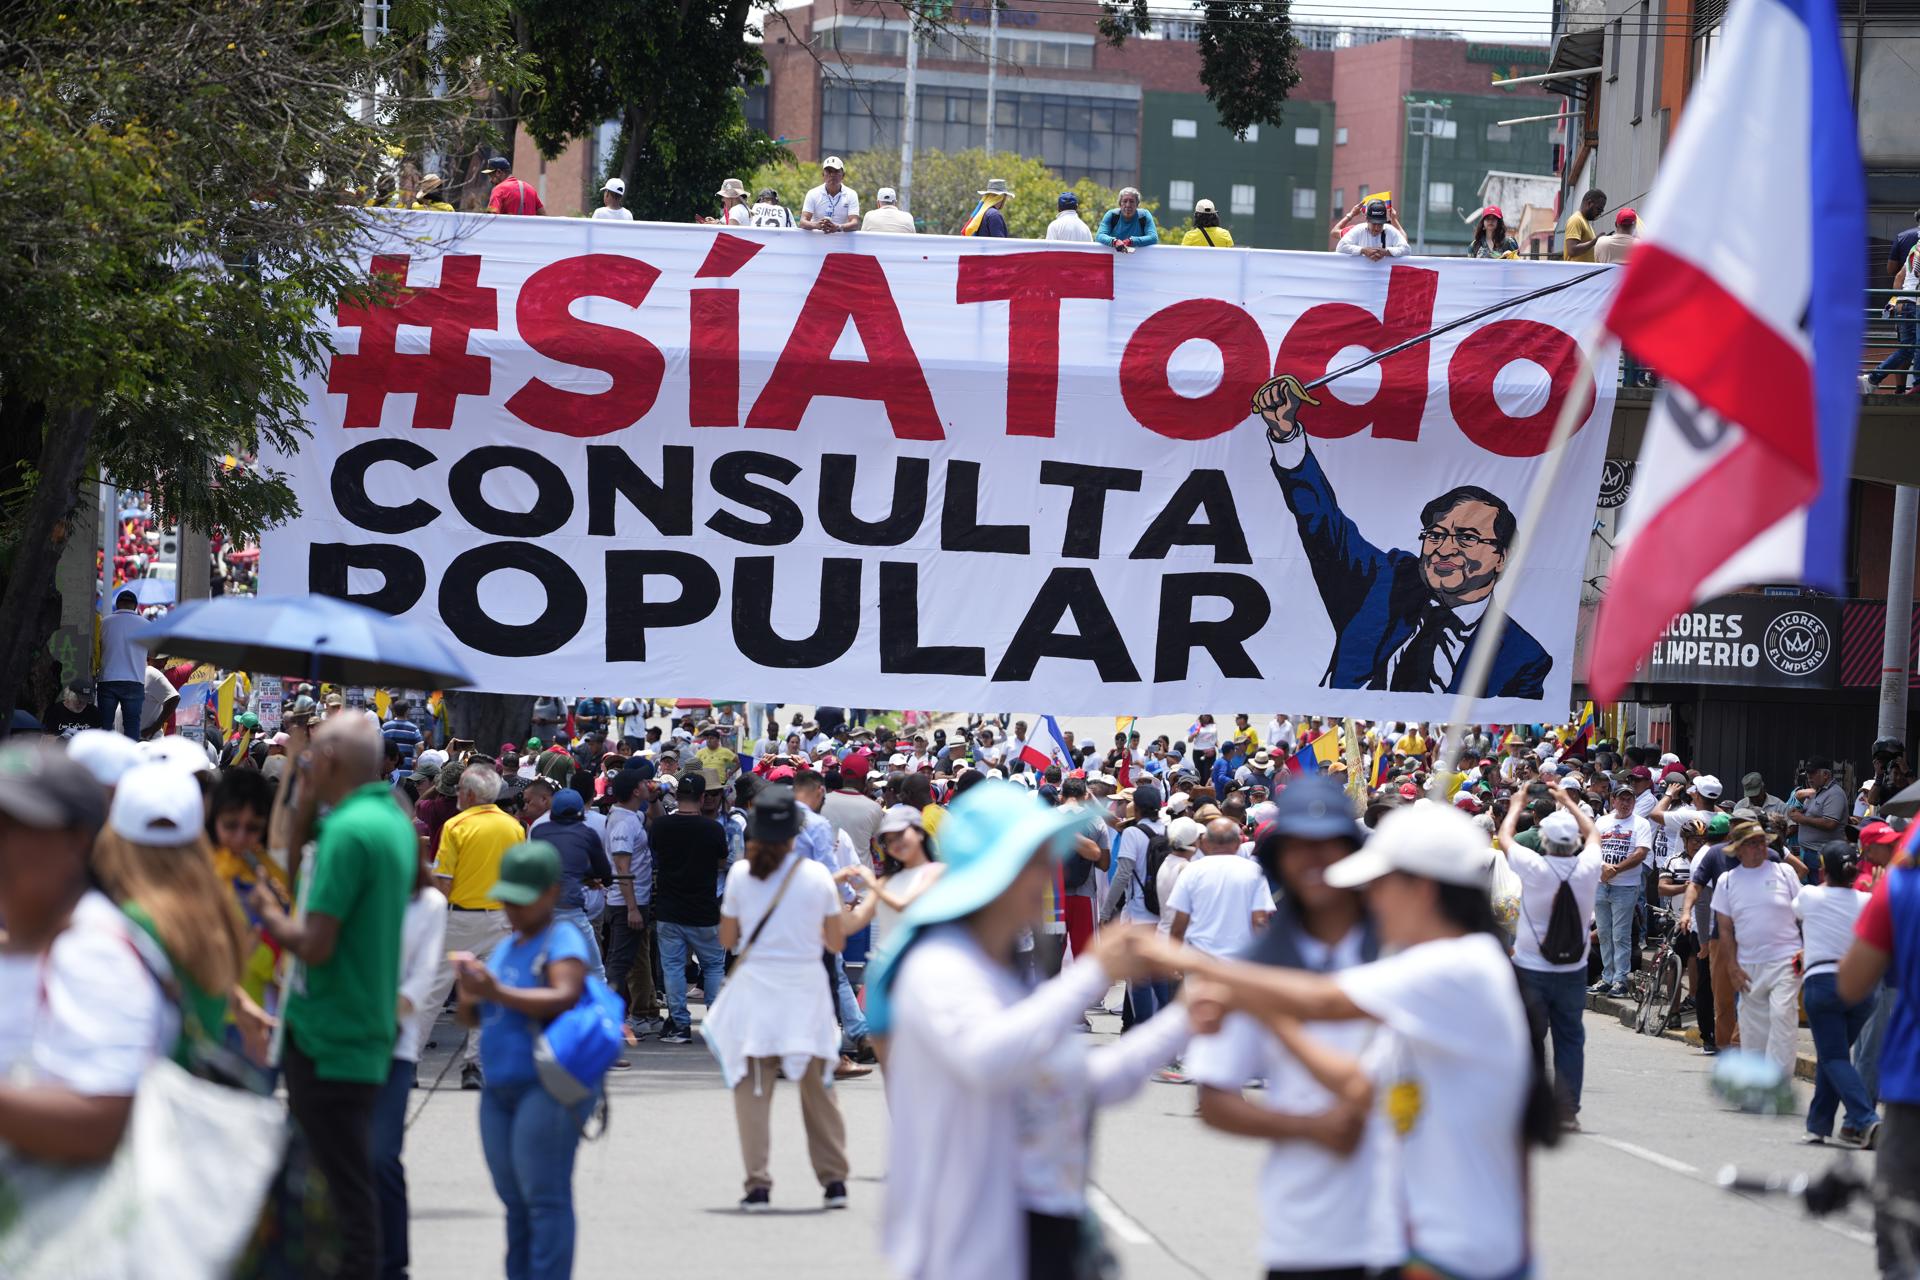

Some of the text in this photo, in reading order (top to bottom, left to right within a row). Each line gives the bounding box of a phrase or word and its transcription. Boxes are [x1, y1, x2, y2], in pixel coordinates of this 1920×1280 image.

[755, 207, 783, 217] SINCE
[330, 438, 1253, 564] CONSULTA
[1598, 485, 1631, 506] PERIO
[309, 541, 1271, 683] POPULAR
[1659, 613, 1743, 638] ICORES
[1774, 615, 1822, 634] LICORES
[1652, 641, 1760, 668] EL IMPERIO
[1769, 648, 1823, 672] EL IMPERIO
